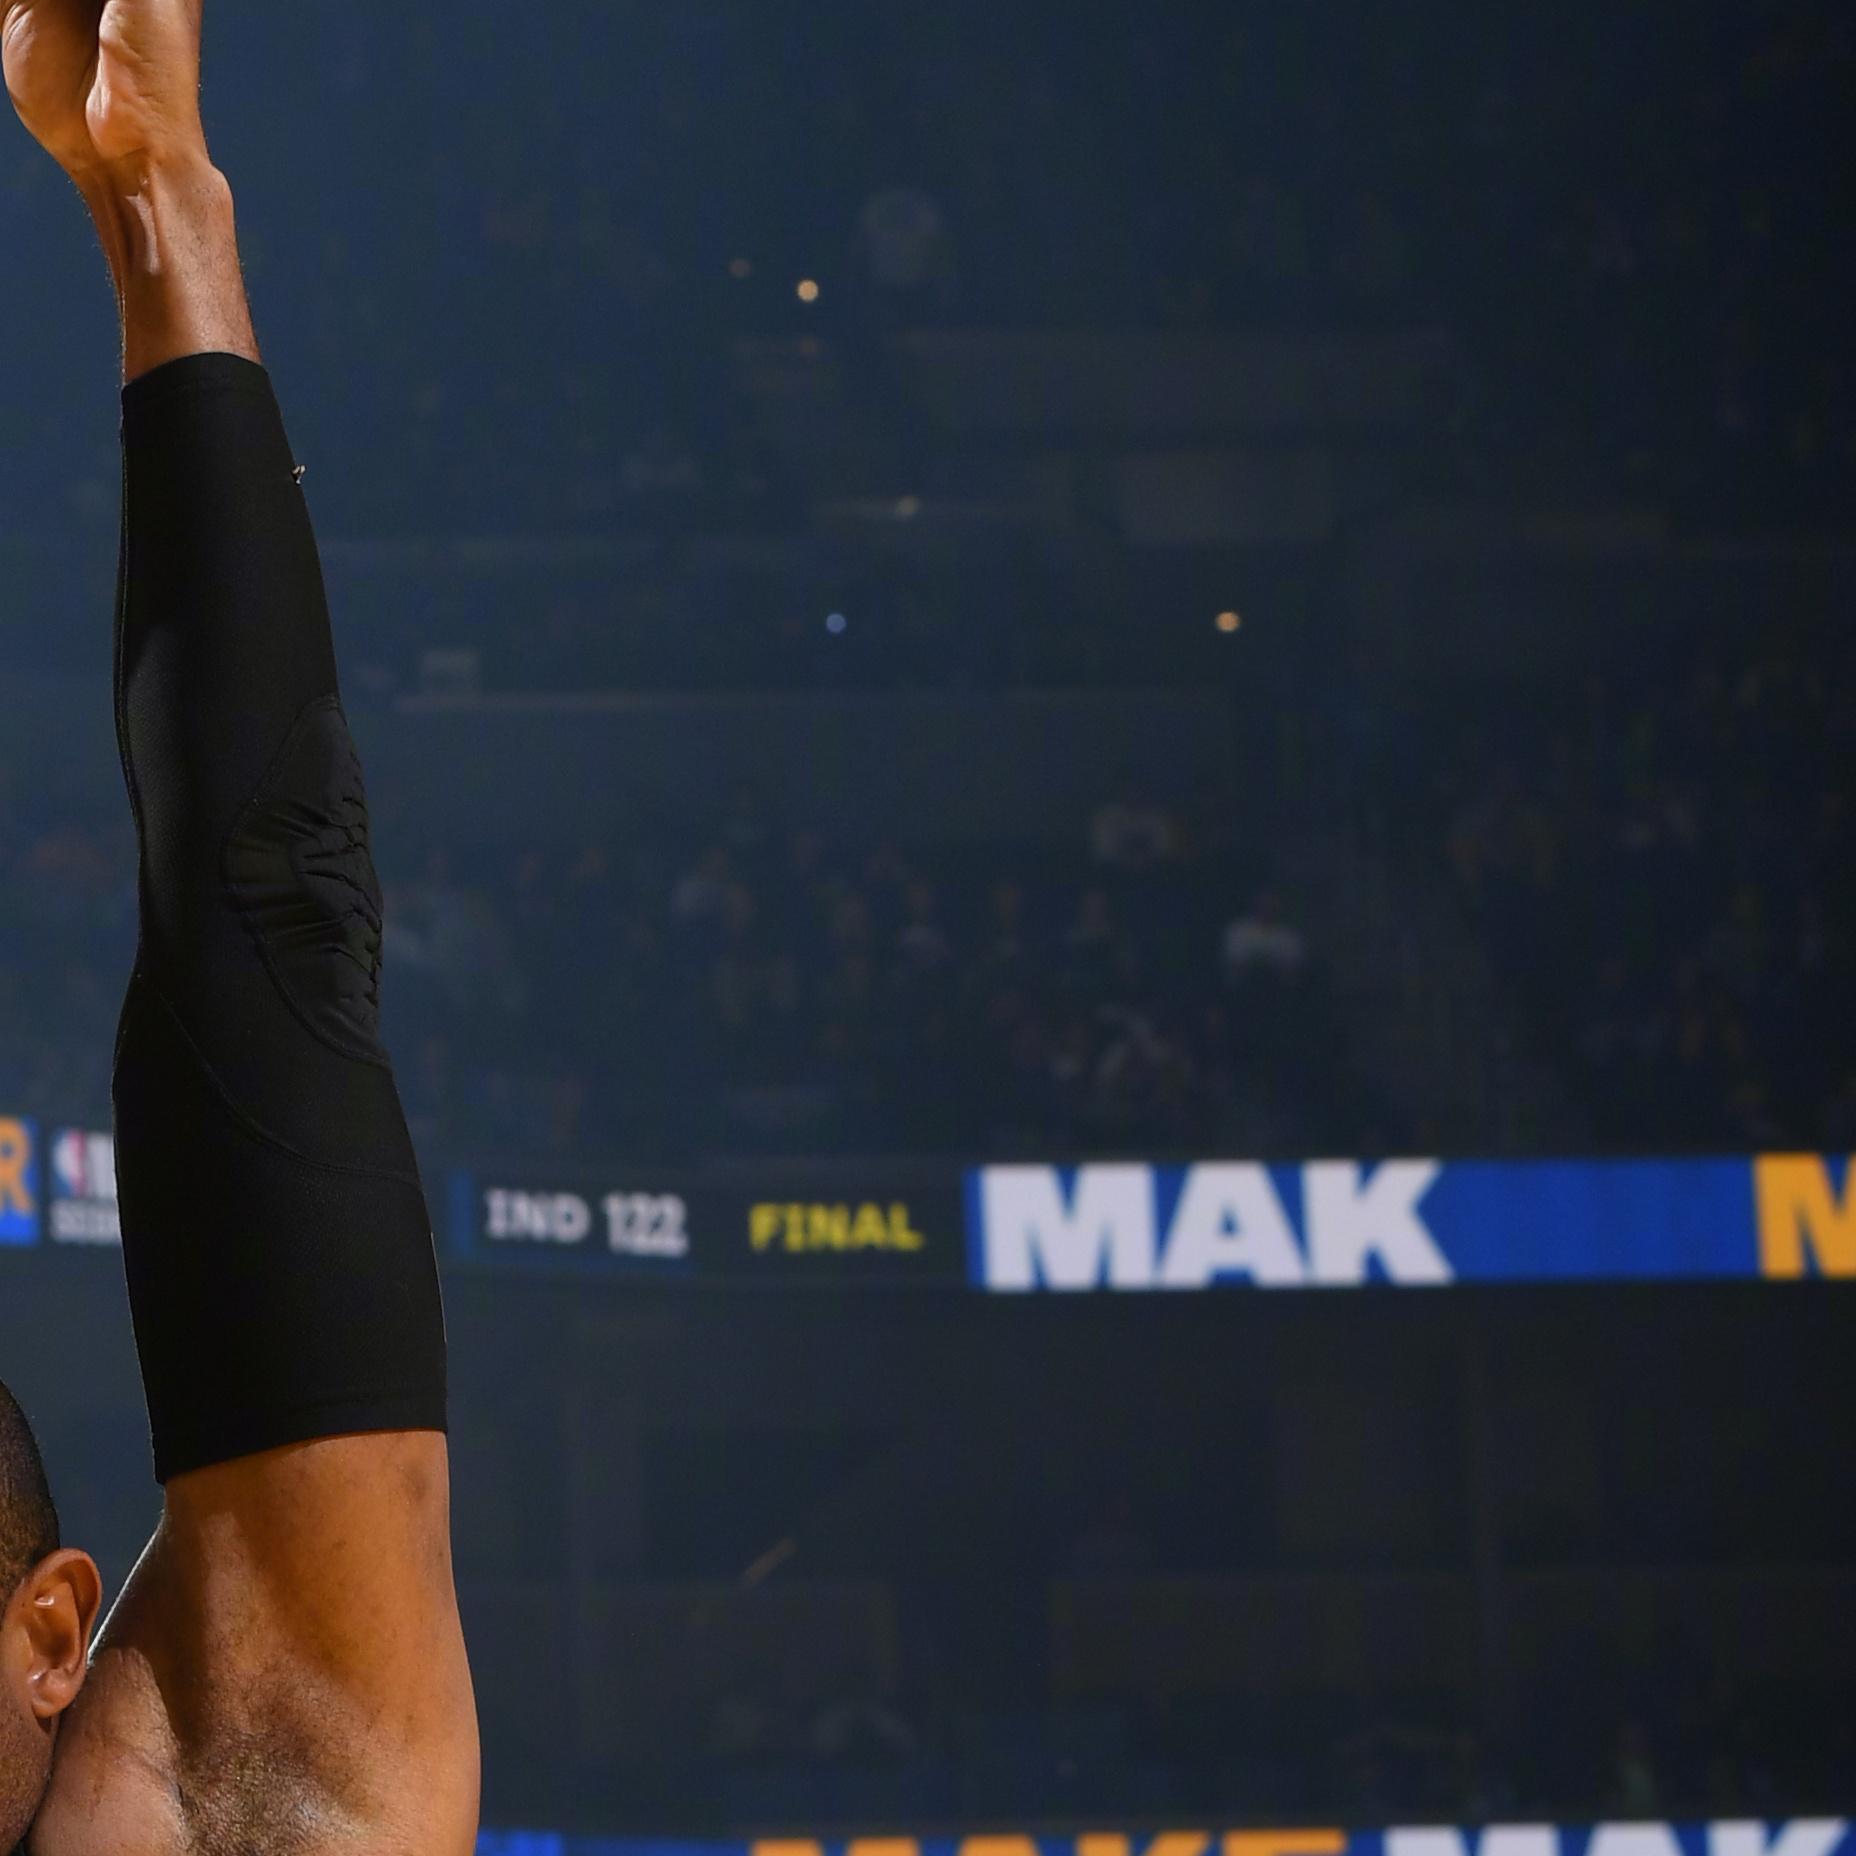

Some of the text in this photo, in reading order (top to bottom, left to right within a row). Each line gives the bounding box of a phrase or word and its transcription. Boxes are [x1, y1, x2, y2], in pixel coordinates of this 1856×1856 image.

[486, 1187, 924, 1257] IND 122 FINAL
[979, 1157, 1454, 1293] MAK
